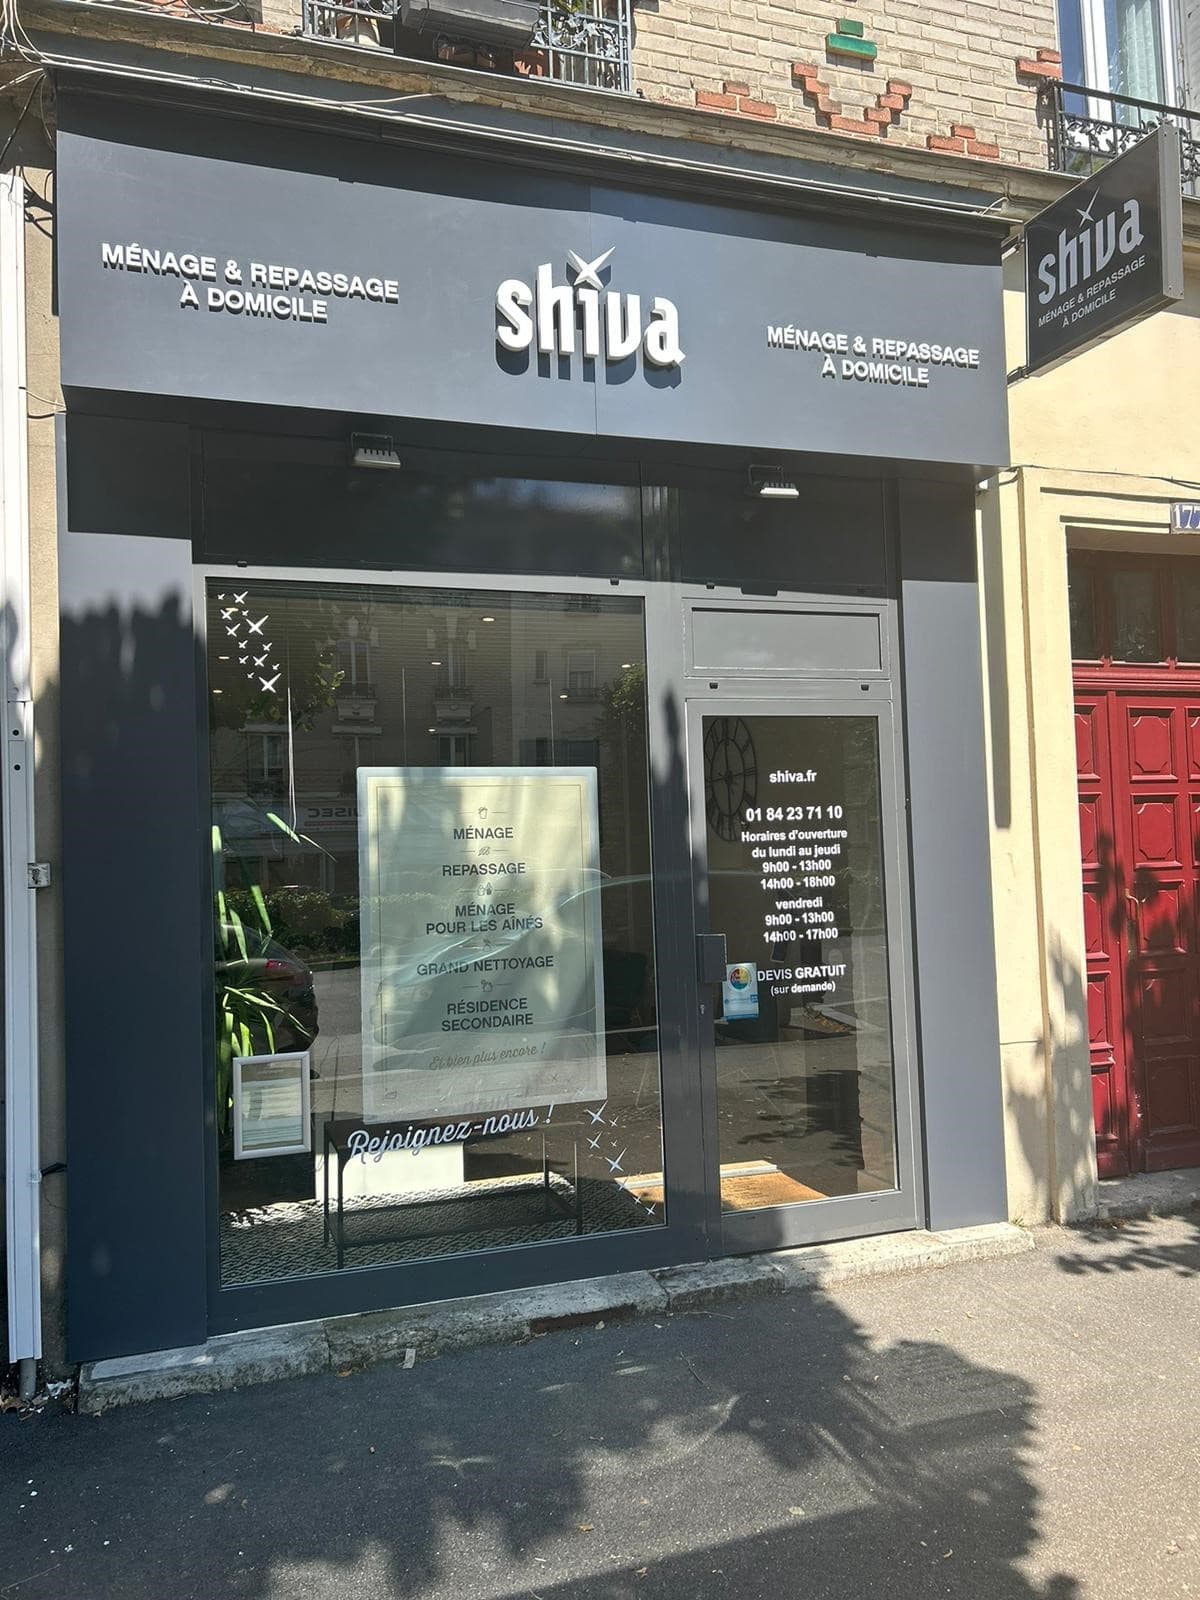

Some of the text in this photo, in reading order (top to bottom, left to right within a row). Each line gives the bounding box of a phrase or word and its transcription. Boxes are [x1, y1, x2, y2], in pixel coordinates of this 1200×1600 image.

[1038, 186, 1144, 305] shiva
[101, 243, 399, 300] MÉNAGE & REPASSAGE
[180, 279, 327, 319] À DOMICILE
[1038, 255, 1147, 327] MÉNAGE & REPASSAGE
[496, 246, 687, 366] shiva
[1062, 289, 1117, 328] À DOMICILE
[767, 325, 980, 365] MÉNAGE & REPASSAGE
[822, 354, 930, 385] À DOMICILE
[769, 770, 817, 783] shiva.fr
[746, 805, 843, 821] 01 84 23 71 10
[453, 825, 514, 840] MÉNAGE
[741, 829, 848, 842] Horaires d'ouverture
[751, 844, 841, 858] du lundi au jeudi
[442, 862, 527, 877] REPASSAGE
[762, 861, 790, 873] 9h00
[799, 859, 831, 871] 13h00
[760, 878, 794, 890] 14h00
[803, 875, 836, 888] 18h00
[455, 902, 515, 917] MÉNAGE
[775, 896, 823, 910] vendredi
[426, 915, 543, 935] POUR LES AÎNÉS
[765, 914, 792, 926] 9h00
[802, 911, 834, 924] 13h00
[763, 930, 796, 943] 14h00
[805, 928, 839, 940] 17h00
[416, 955, 554, 976] GRAND NETTOYAGE
[757, 964, 847, 981] DEVIS GRATUIT
[770, 981, 836, 997] (sur demande)
[446, 997, 528, 1016] RÉSIDENCE
[441, 1013, 533, 1032] SECONDAIRE
[472, 1050, 497, 1067] plus
[500, 1044, 539, 1060] encore
[347, 1107, 540, 1165] Rejoignez-nous
[546, 1103, 555, 1125] !
